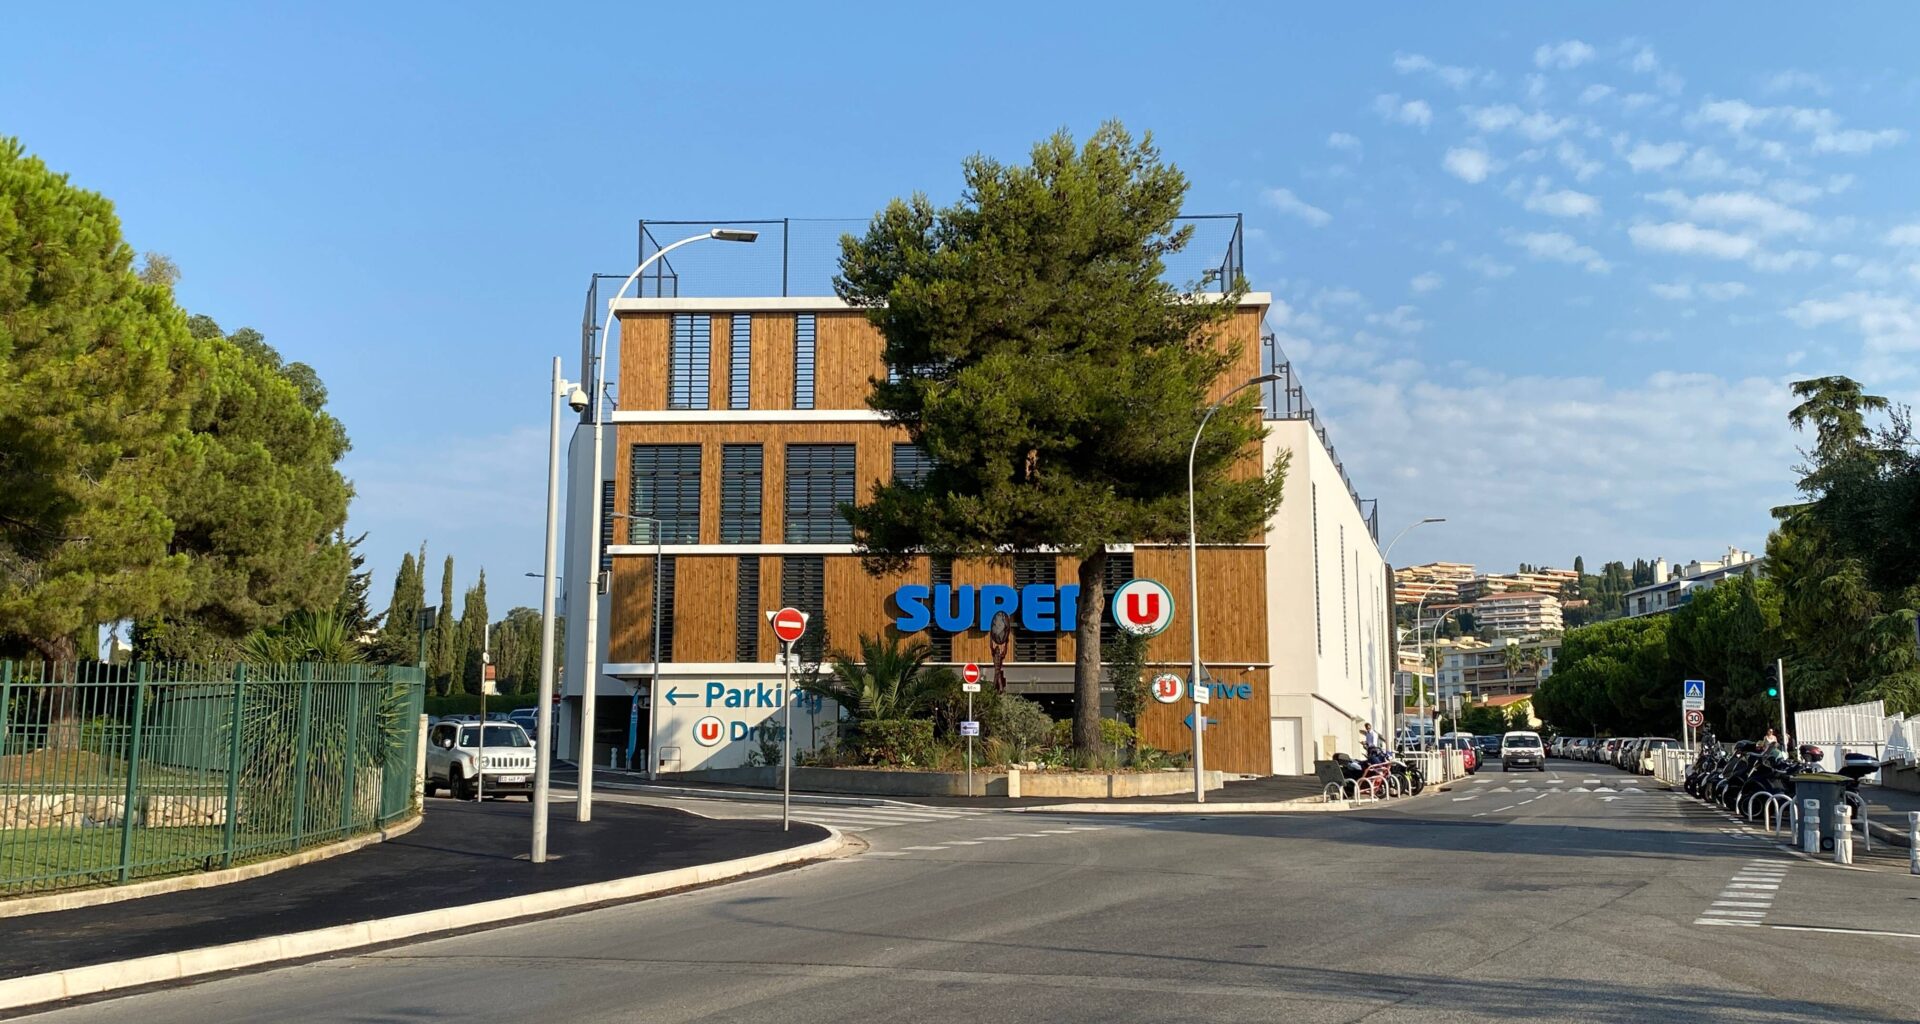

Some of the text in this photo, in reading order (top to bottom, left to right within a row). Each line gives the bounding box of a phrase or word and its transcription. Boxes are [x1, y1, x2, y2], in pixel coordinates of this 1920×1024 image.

[1127, 593, 1160, 624] U
[1159, 681, 1176, 697] U
[1689, 714, 1700, 722] 30
[701, 724, 718, 740] U
